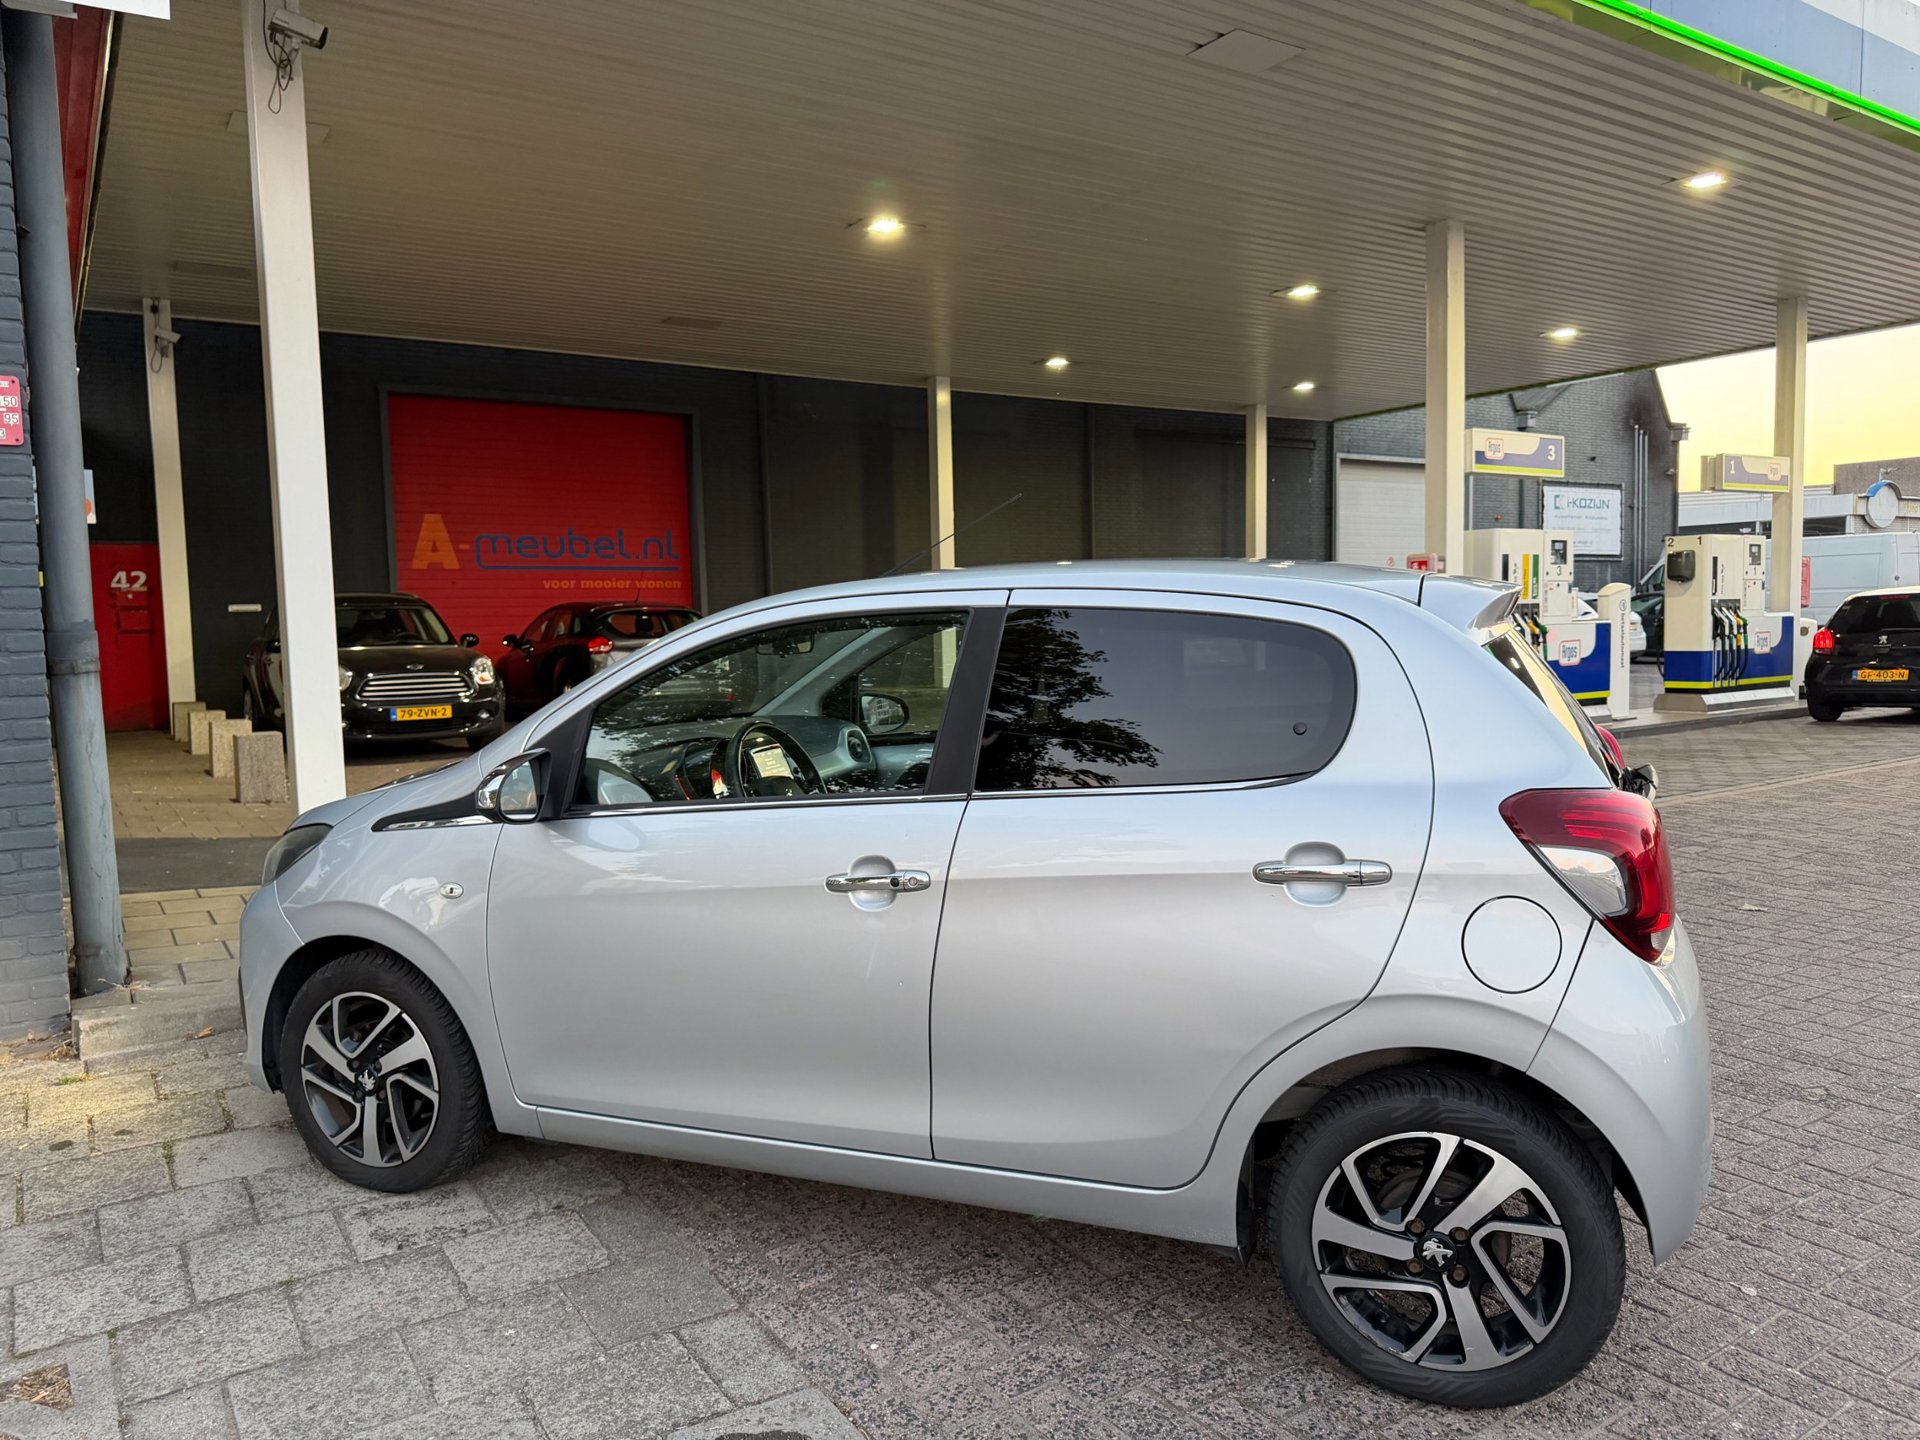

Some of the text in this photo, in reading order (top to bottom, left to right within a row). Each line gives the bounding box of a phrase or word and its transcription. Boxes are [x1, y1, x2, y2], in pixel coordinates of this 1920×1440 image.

[1547, 444, 1556, 461] 3
[1730, 460, 1736, 474] 1
[1667, 537, 1675, 548] 2
[1697, 536, 1702, 545] 1
[1556, 565, 1562, 577] 3
[110, 570, 148, 591] 42
[543, 577, 681, 589] voor mooier wonen
